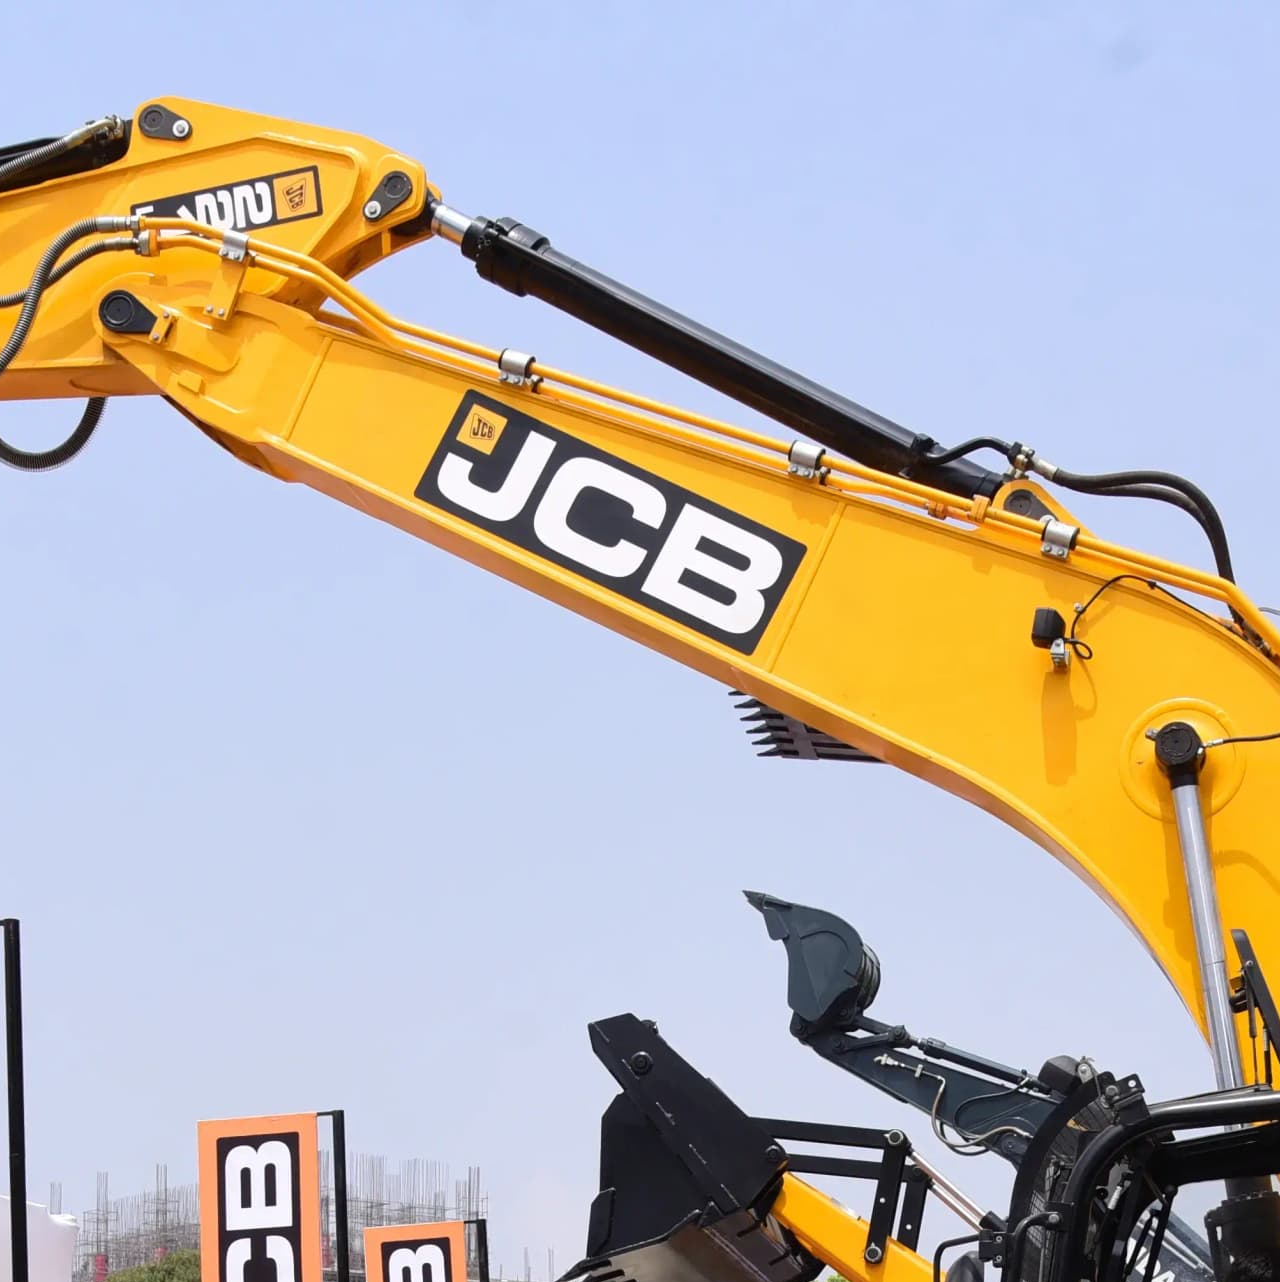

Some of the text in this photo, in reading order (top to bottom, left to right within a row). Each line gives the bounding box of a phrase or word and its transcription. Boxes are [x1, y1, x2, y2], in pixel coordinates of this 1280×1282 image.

[286, 184, 305, 209] JCB
[471, 416, 495, 440] JCB
[437, 430, 783, 634] JCB
